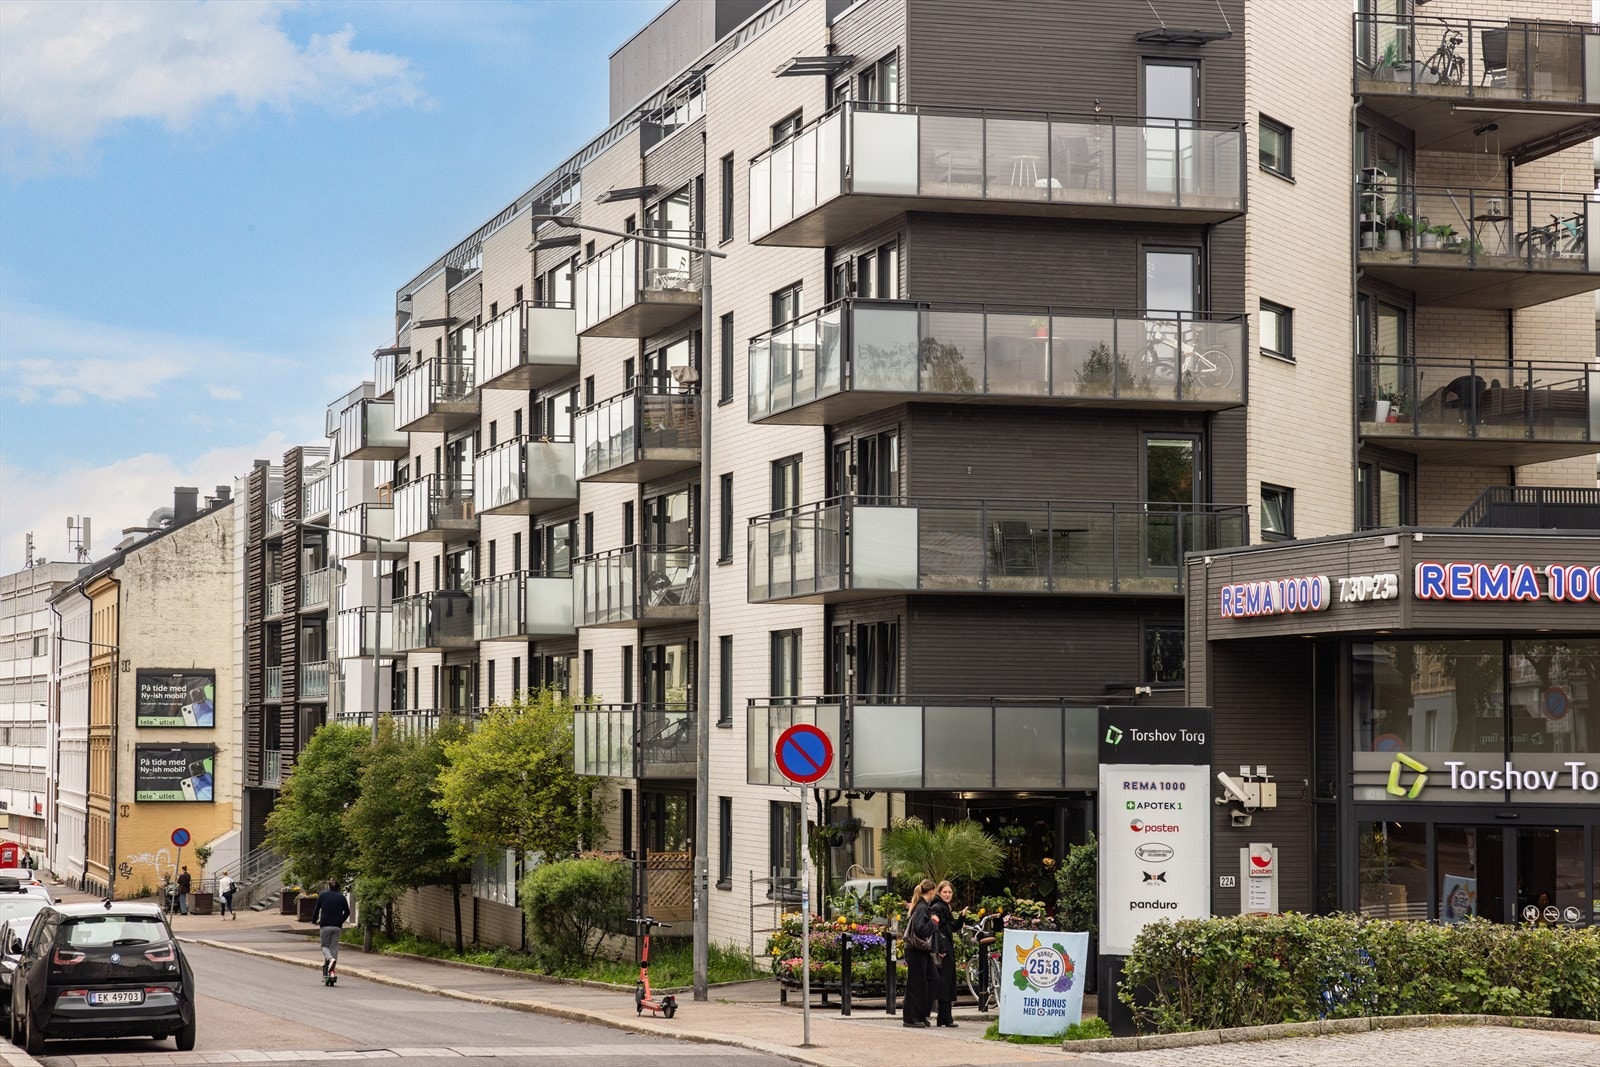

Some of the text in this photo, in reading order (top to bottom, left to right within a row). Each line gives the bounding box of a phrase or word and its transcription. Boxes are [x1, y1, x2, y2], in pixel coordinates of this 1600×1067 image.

[1415, 561, 1600, 602] REMA 10
[1338, 573, 1398, 603] 7.30-23
[1220, 575, 1329, 619] REMA 1000
[141, 684, 151, 692] På
[152, 684, 168, 692] tide
[141, 692, 163, 700] Ny-ish
[1129, 728, 1205, 745] Torshov Torg
[140, 758, 150, 766] På
[140, 766, 162, 774] Ny-ish
[1443, 761, 1559, 791] Torshov
[1123, 781, 1186, 791] REMA 1000
[1136, 801, 1183, 810] APOTEK 1
[1144, 824, 1180, 834] posten
[1221, 877, 1234, 886] 22A
[1130, 899, 1178, 911] panduro
[1030, 959, 1044, 974] 25
[1052, 960, 1060, 975] 8
[98, 992, 139, 1002] EK 49703
[1024, 997, 1066, 1008] TJEN BONUS
